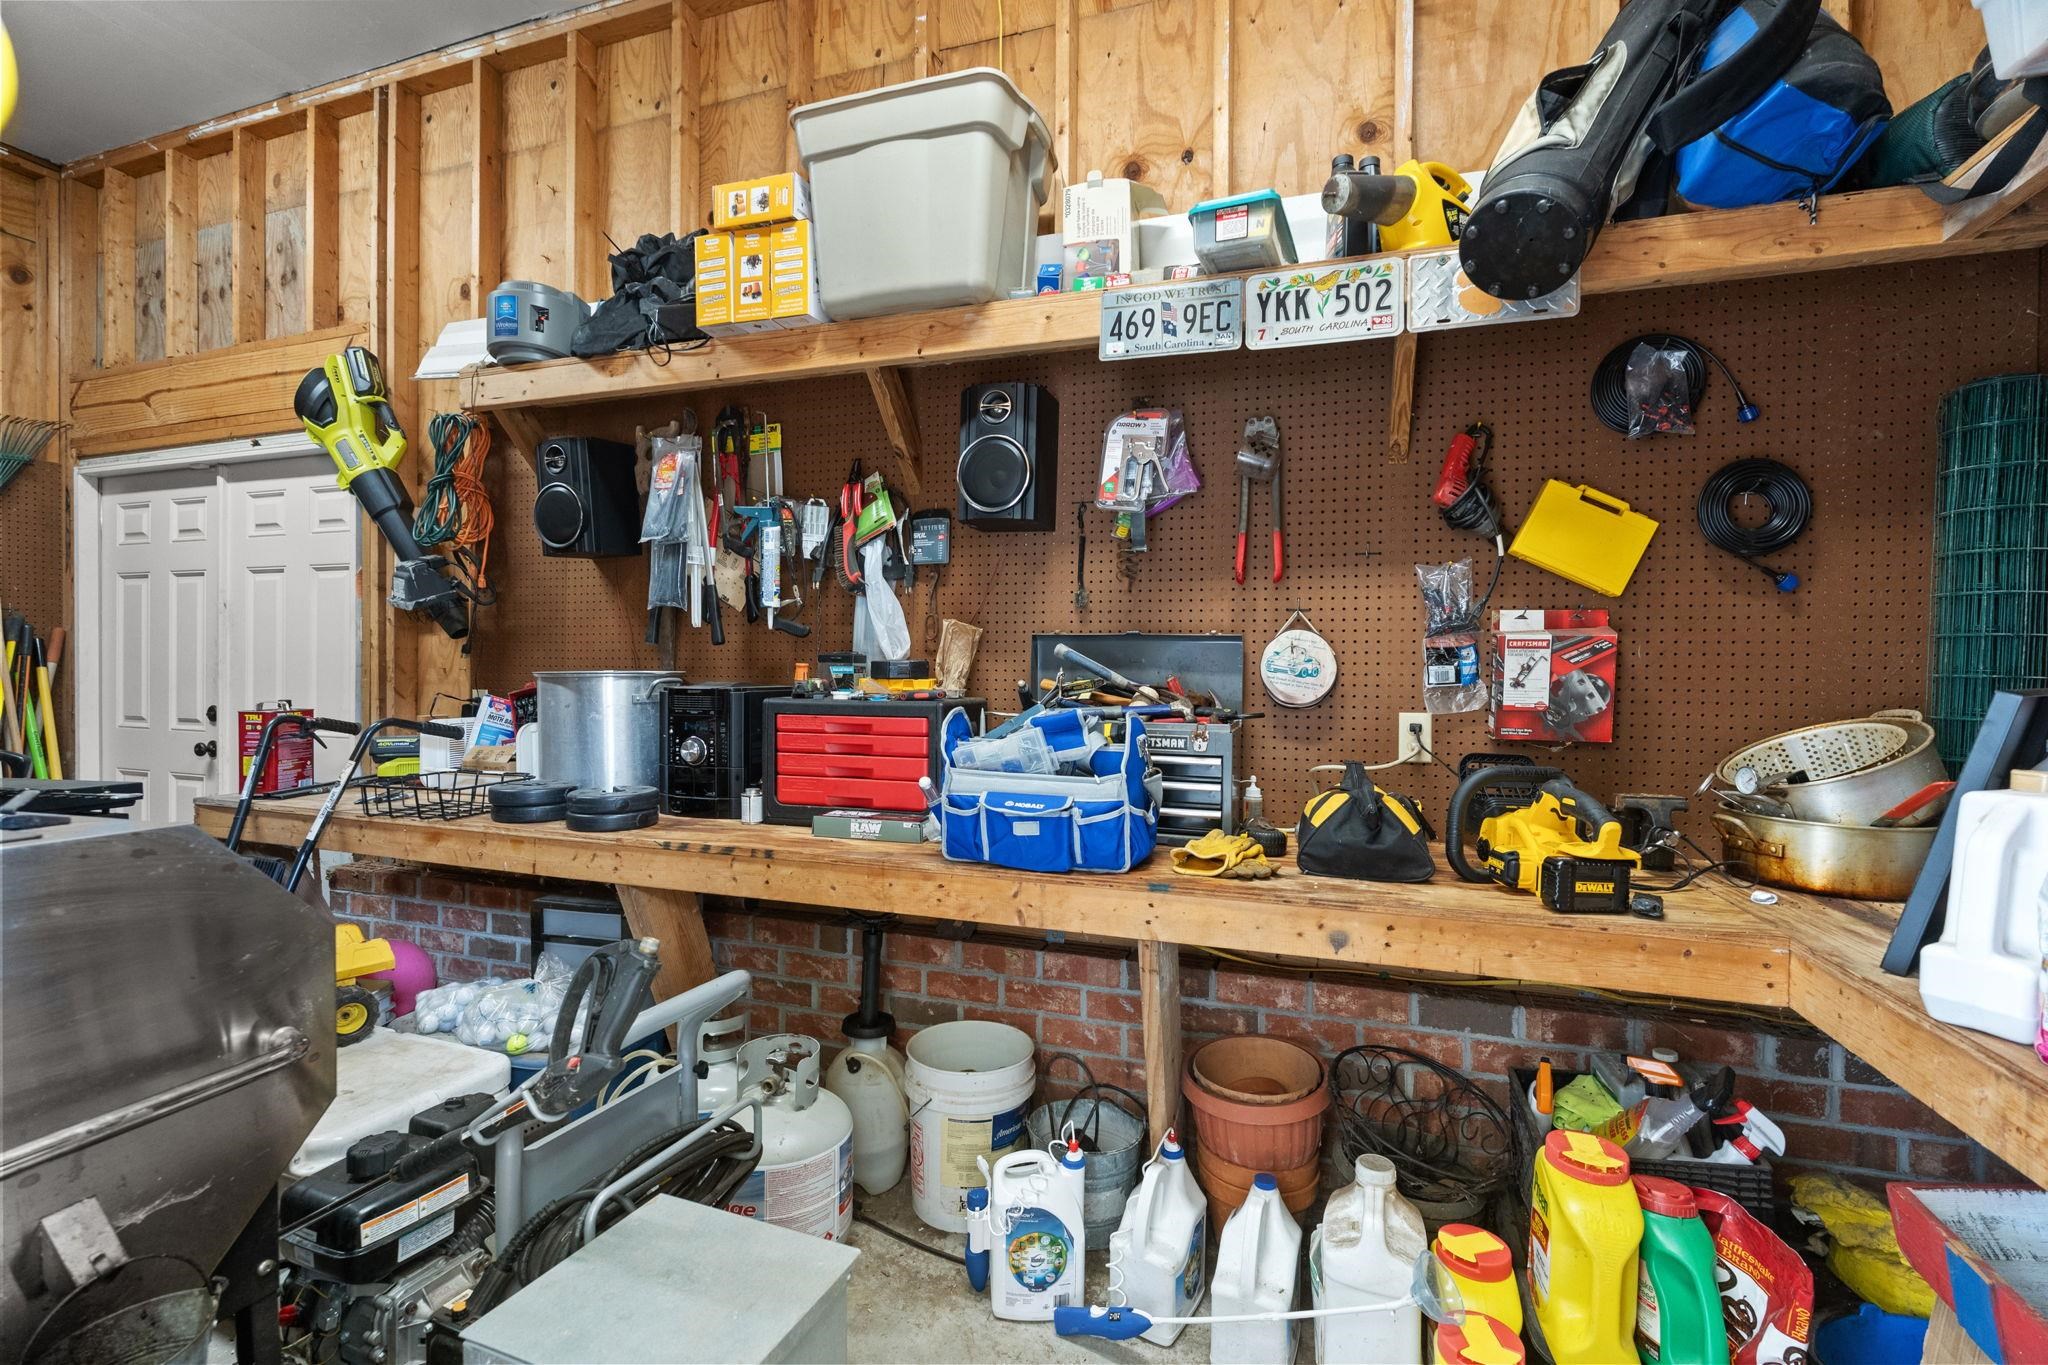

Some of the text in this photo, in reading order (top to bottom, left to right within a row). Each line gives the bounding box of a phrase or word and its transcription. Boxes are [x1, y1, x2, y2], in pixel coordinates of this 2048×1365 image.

[1134, 291, 1162, 302] GOD
[1164, 288, 1185, 299] WE
[1187, 284, 1231, 297] TRUST
[1256, 278, 1393, 324] YKK 502
[1109, 300, 1232, 341] 469 9EC
[1381, 315, 1393, 324] 98
[1280, 318, 1369, 336] SOUTH CAROLINA
[1257, 328, 1266, 341] 7
[1134, 338, 1205, 353] South Carolina
[1508, 640, 1549, 648] CRAFTSMAN
[488, 713, 505, 723] MOTH
[1148, 737, 1186, 748] TSMAN
[850, 822, 882, 834] RAW
[1574, 881, 1615, 894] DEWALT
